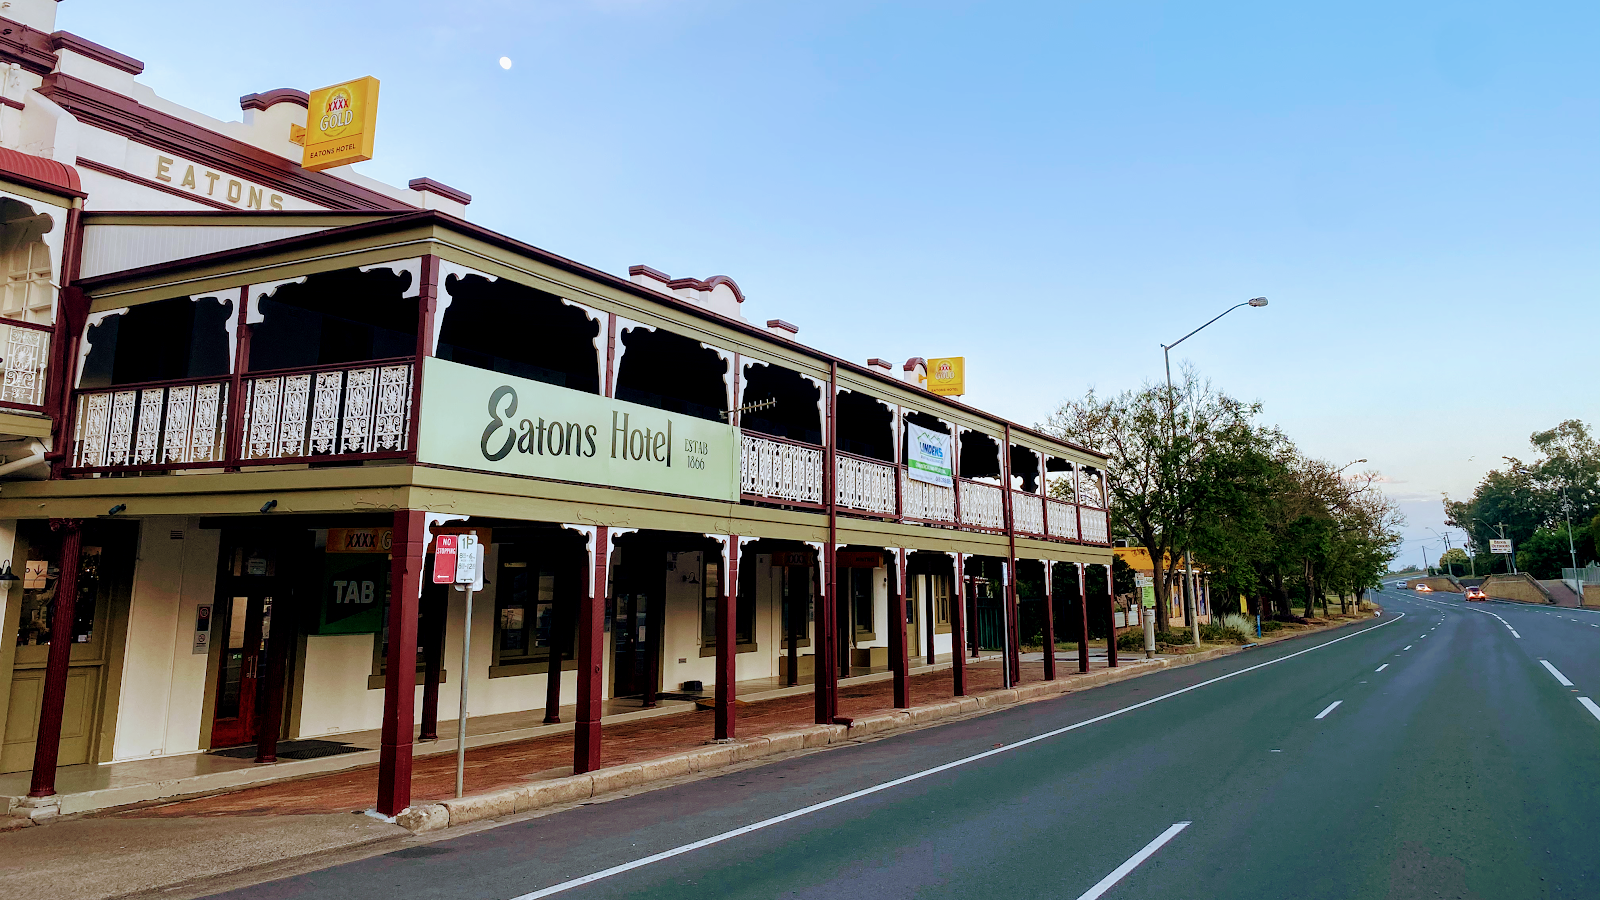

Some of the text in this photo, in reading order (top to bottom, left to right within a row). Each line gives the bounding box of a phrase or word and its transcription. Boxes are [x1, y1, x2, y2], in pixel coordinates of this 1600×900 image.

[327, 98, 349, 113] XXXX
[320, 109, 353, 131] GOLD
[310, 143, 356, 159] EATONS HOTEL
[155, 155, 284, 211] EATONS
[935, 371, 955, 380] GOLD
[480, 385, 672, 467] Eatons Hotel
[685, 438, 708, 456] ESTAB
[687, 455, 705, 470] 1866
[346, 532, 376, 548] XXXX
[442, 537, 452, 546] NO
[462, 536, 474, 549] 1P
[436, 547, 456, 555] STOPPING
[333, 580, 375, 604] TAB
